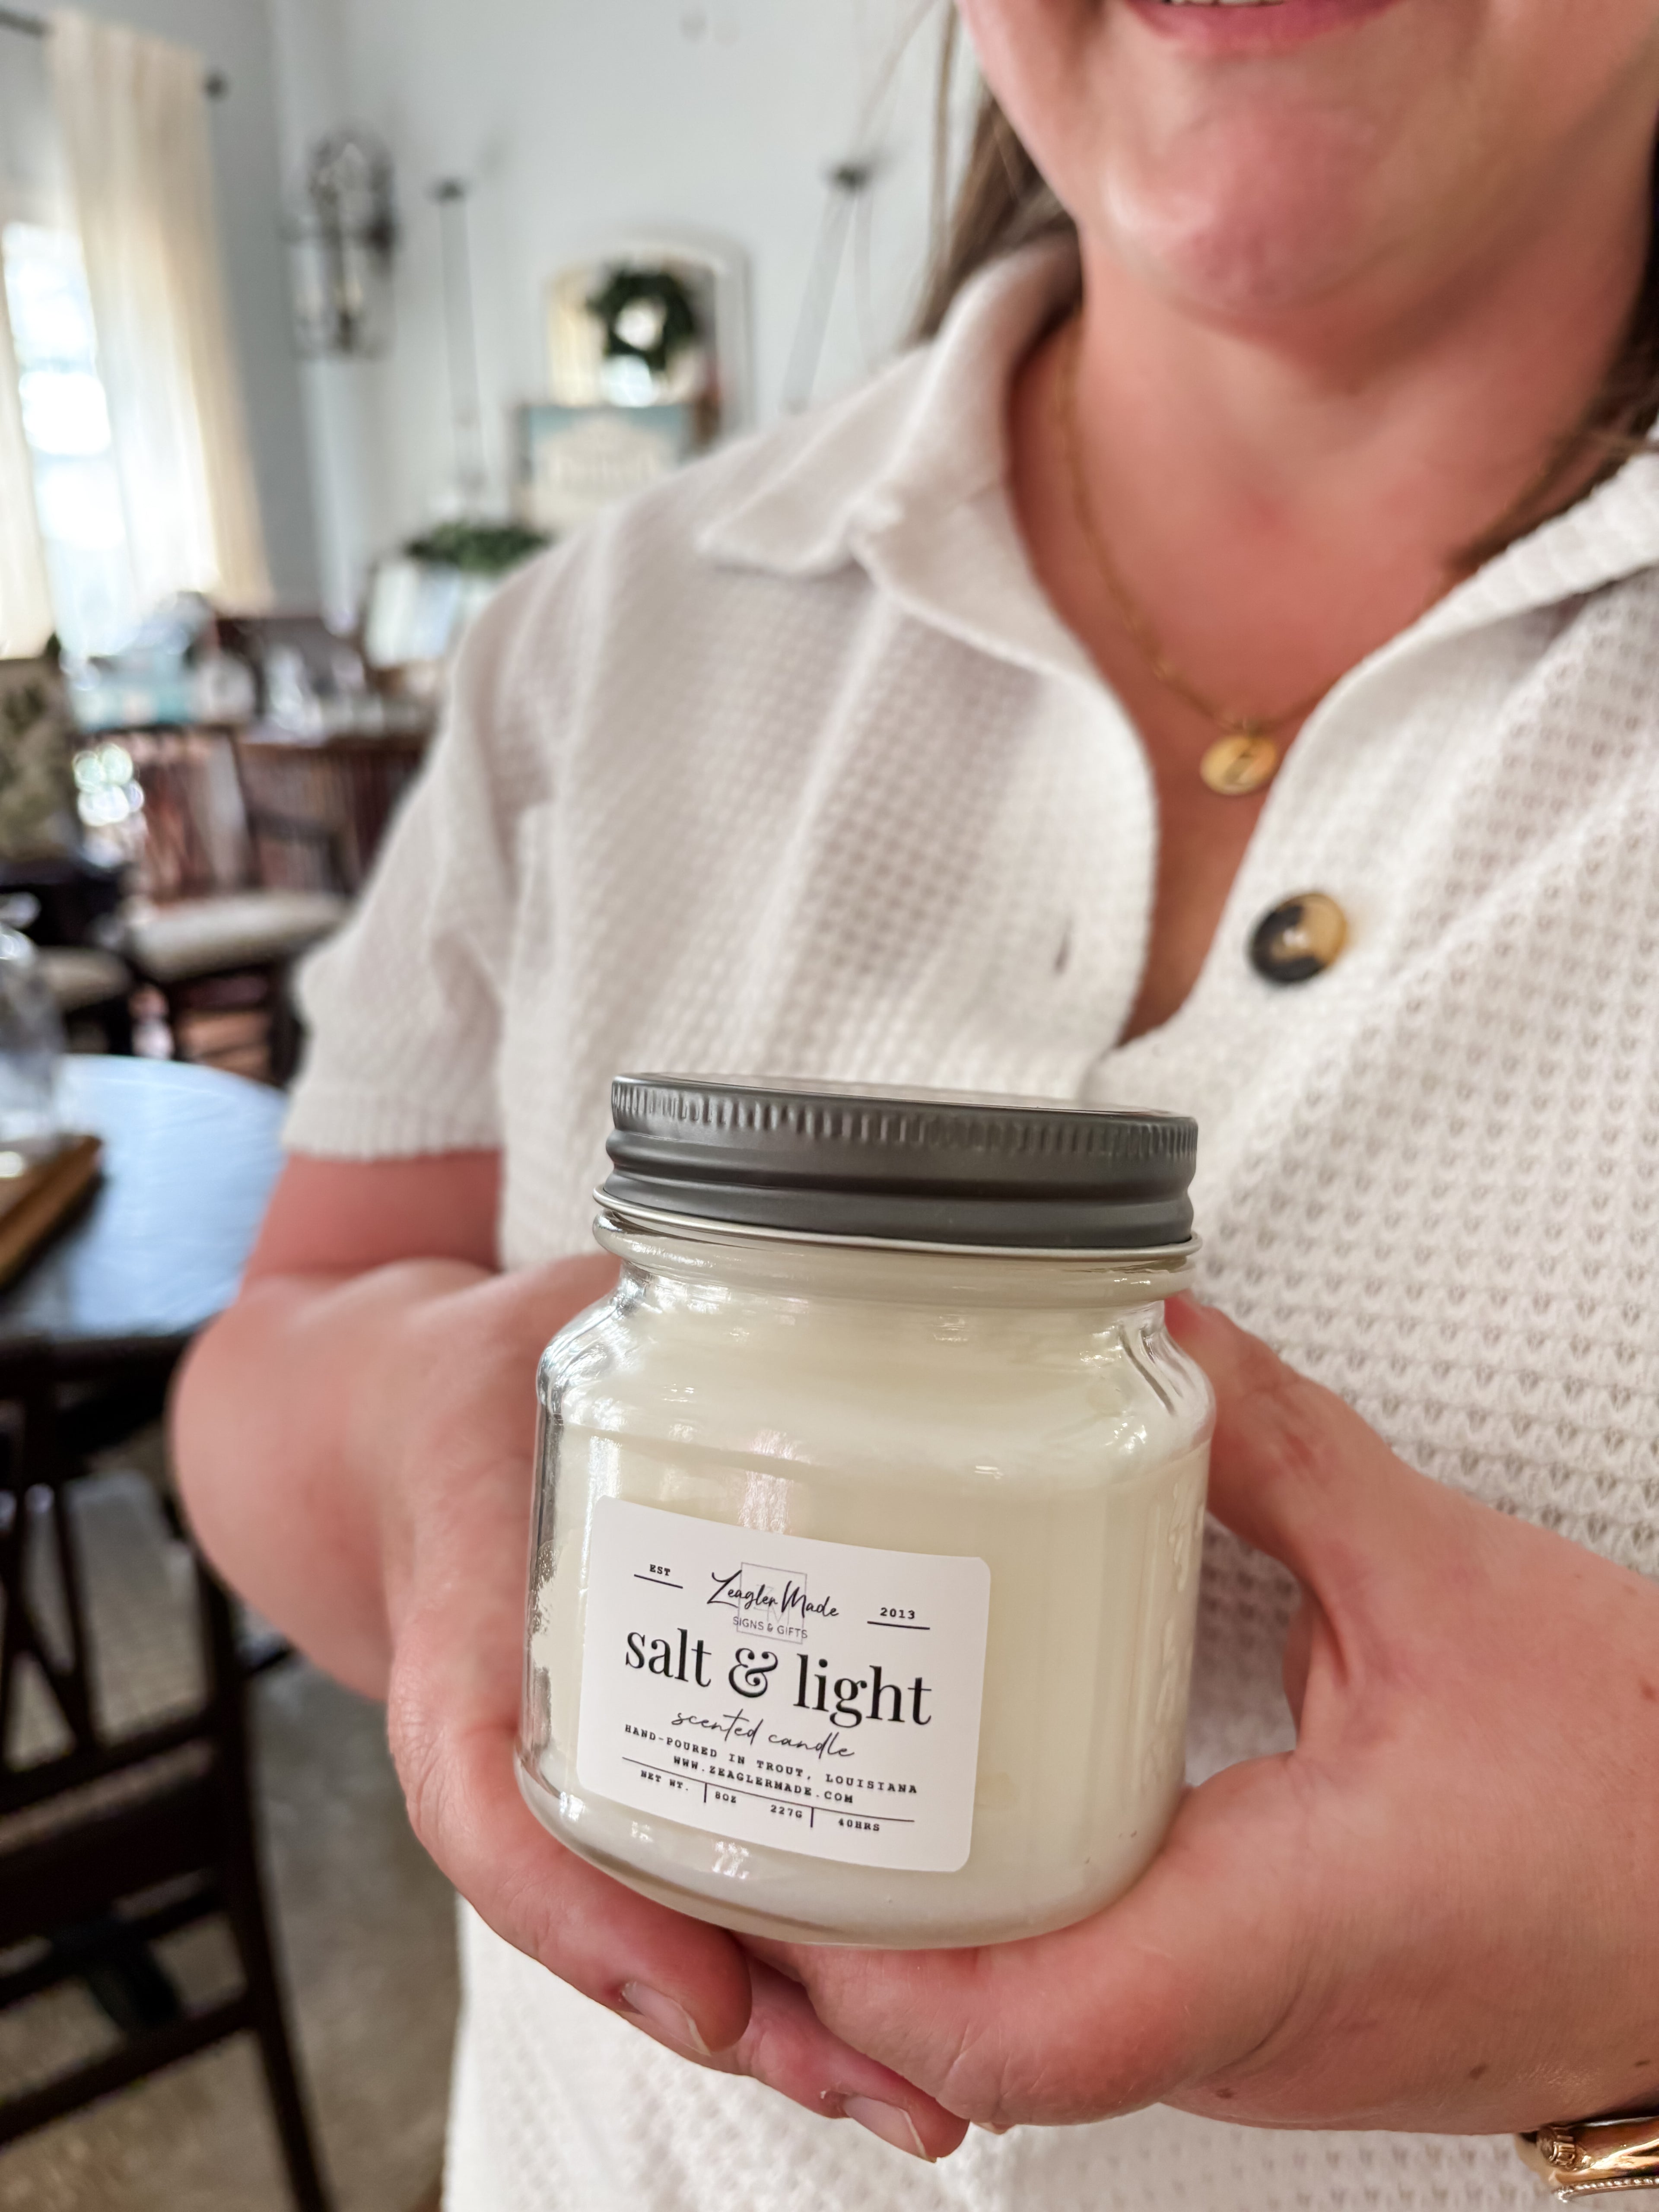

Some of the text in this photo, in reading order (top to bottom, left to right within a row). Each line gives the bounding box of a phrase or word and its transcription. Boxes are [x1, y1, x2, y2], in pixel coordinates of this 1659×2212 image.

[649, 1564, 671, 1576] EST
[707, 1569, 839, 1618] Zeagler Made
[880, 1607, 915, 1620] 2013
[733, 1616, 808, 1639] SIGNS & GIFTS
[626, 1628, 932, 1729] salt & light
[671, 1709, 855, 1759] scented candle
[625, 1724, 917, 1794] HAND-POURED IN TROUT, LOUISIANA
[641, 1770, 688, 1791] NET WT.
[674, 1756, 853, 1803] WWW.ZEAGLERMADE.COM
[715, 1791, 736, 1803] 8OZ
[770, 1805, 802, 1818] 227G
[838, 1818, 880, 1831] 40HRS
